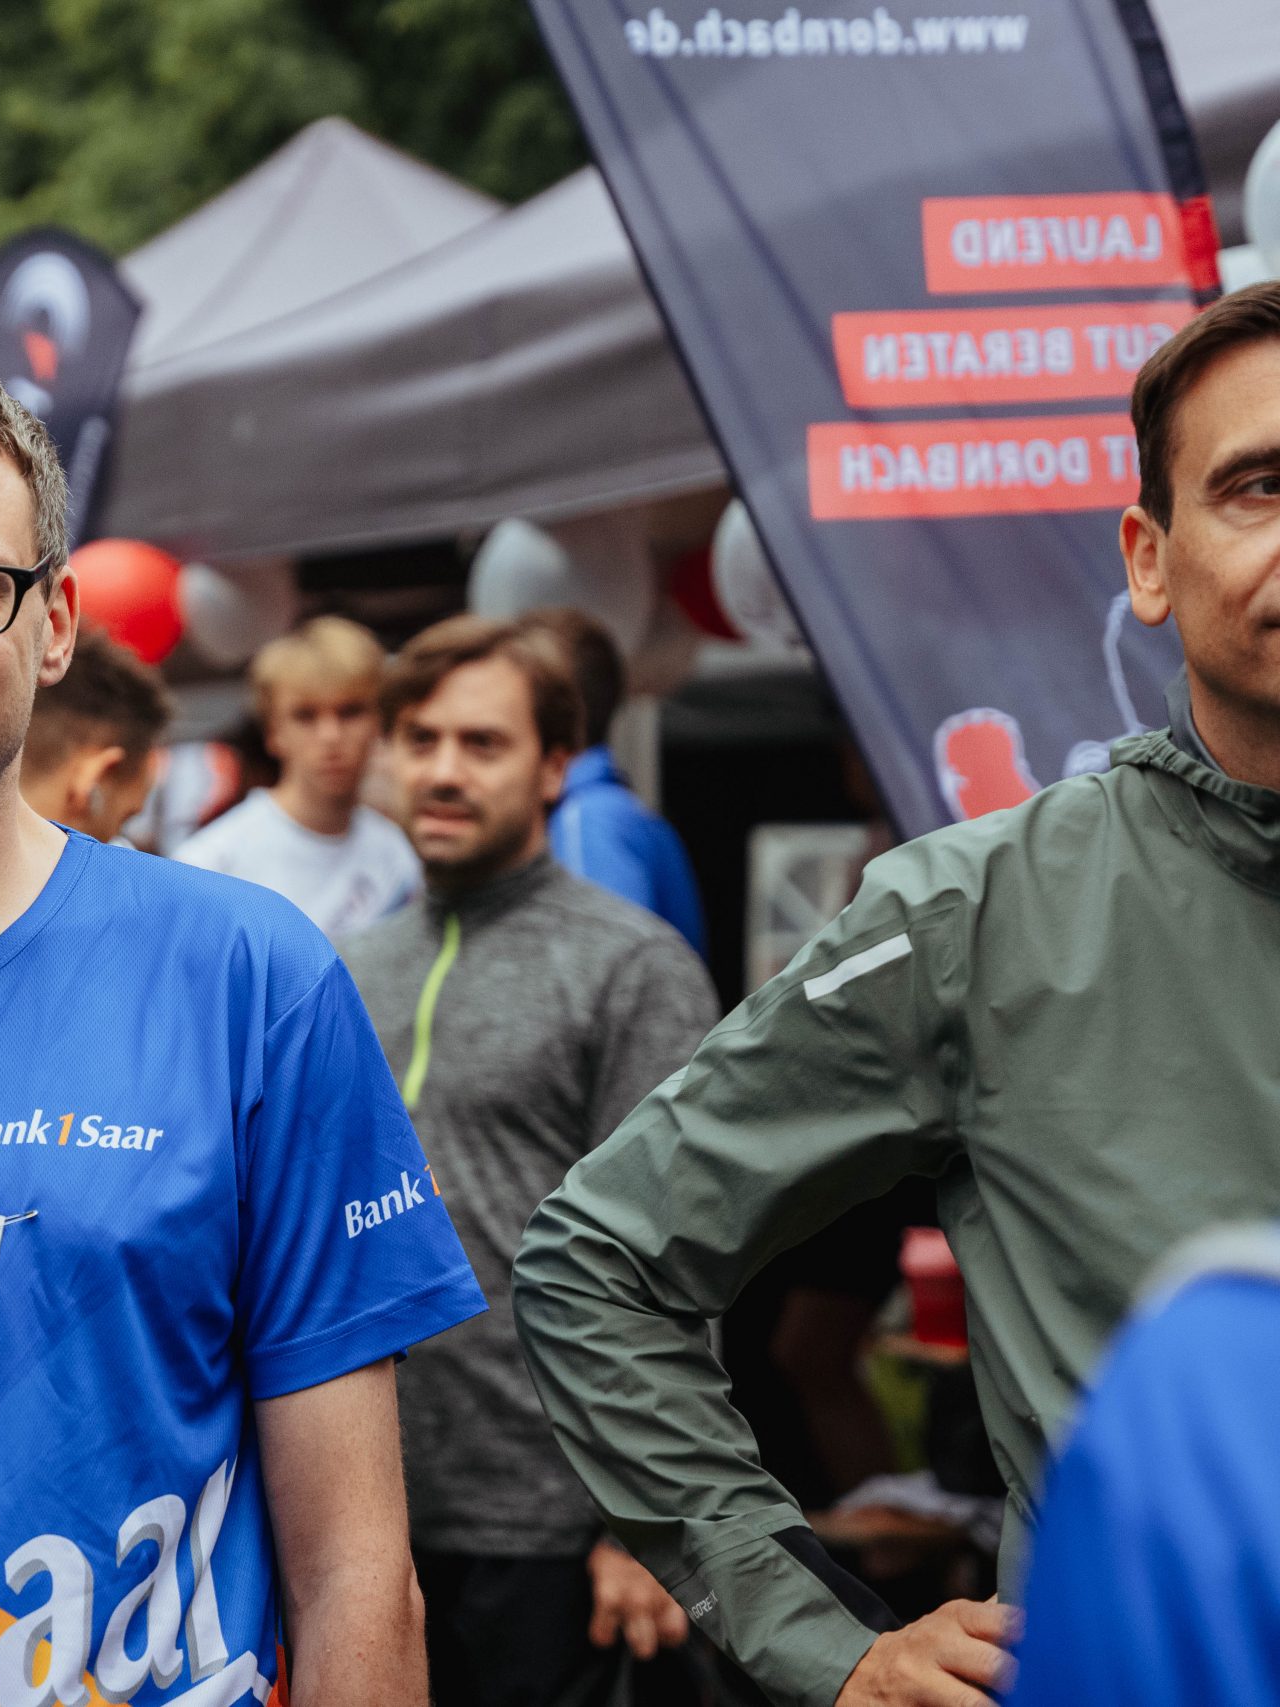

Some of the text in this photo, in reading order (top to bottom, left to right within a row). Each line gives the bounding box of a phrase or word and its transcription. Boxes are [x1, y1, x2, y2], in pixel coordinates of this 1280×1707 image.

[57, 1112, 75, 1146] 1
[76, 1114, 164, 1152] Saar
[345, 1171, 426, 1239] Bank
